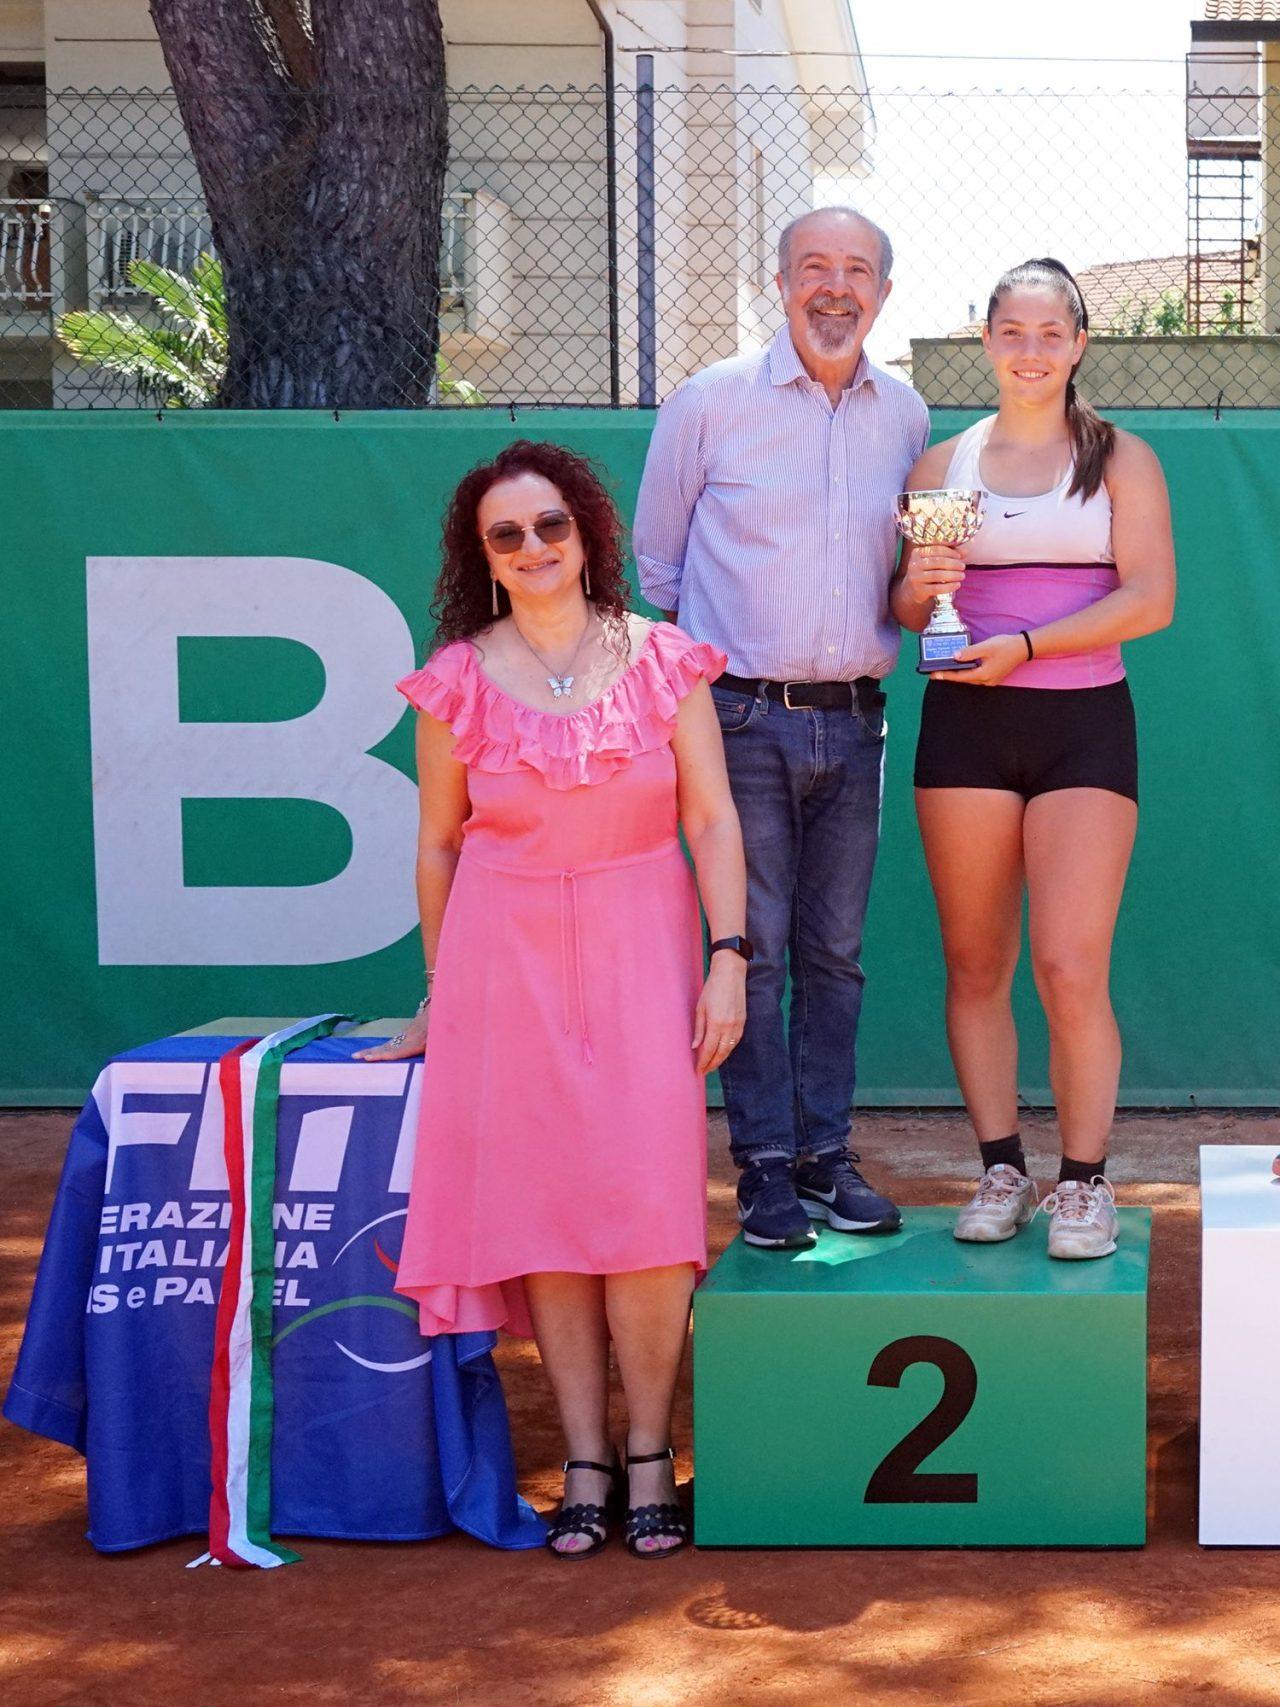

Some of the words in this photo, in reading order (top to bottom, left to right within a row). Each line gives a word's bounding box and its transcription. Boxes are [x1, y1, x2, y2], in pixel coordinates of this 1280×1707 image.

[85, 555, 421, 966] B
[126, 1286, 146, 1309] e
[863, 1335, 978, 1504] 2
